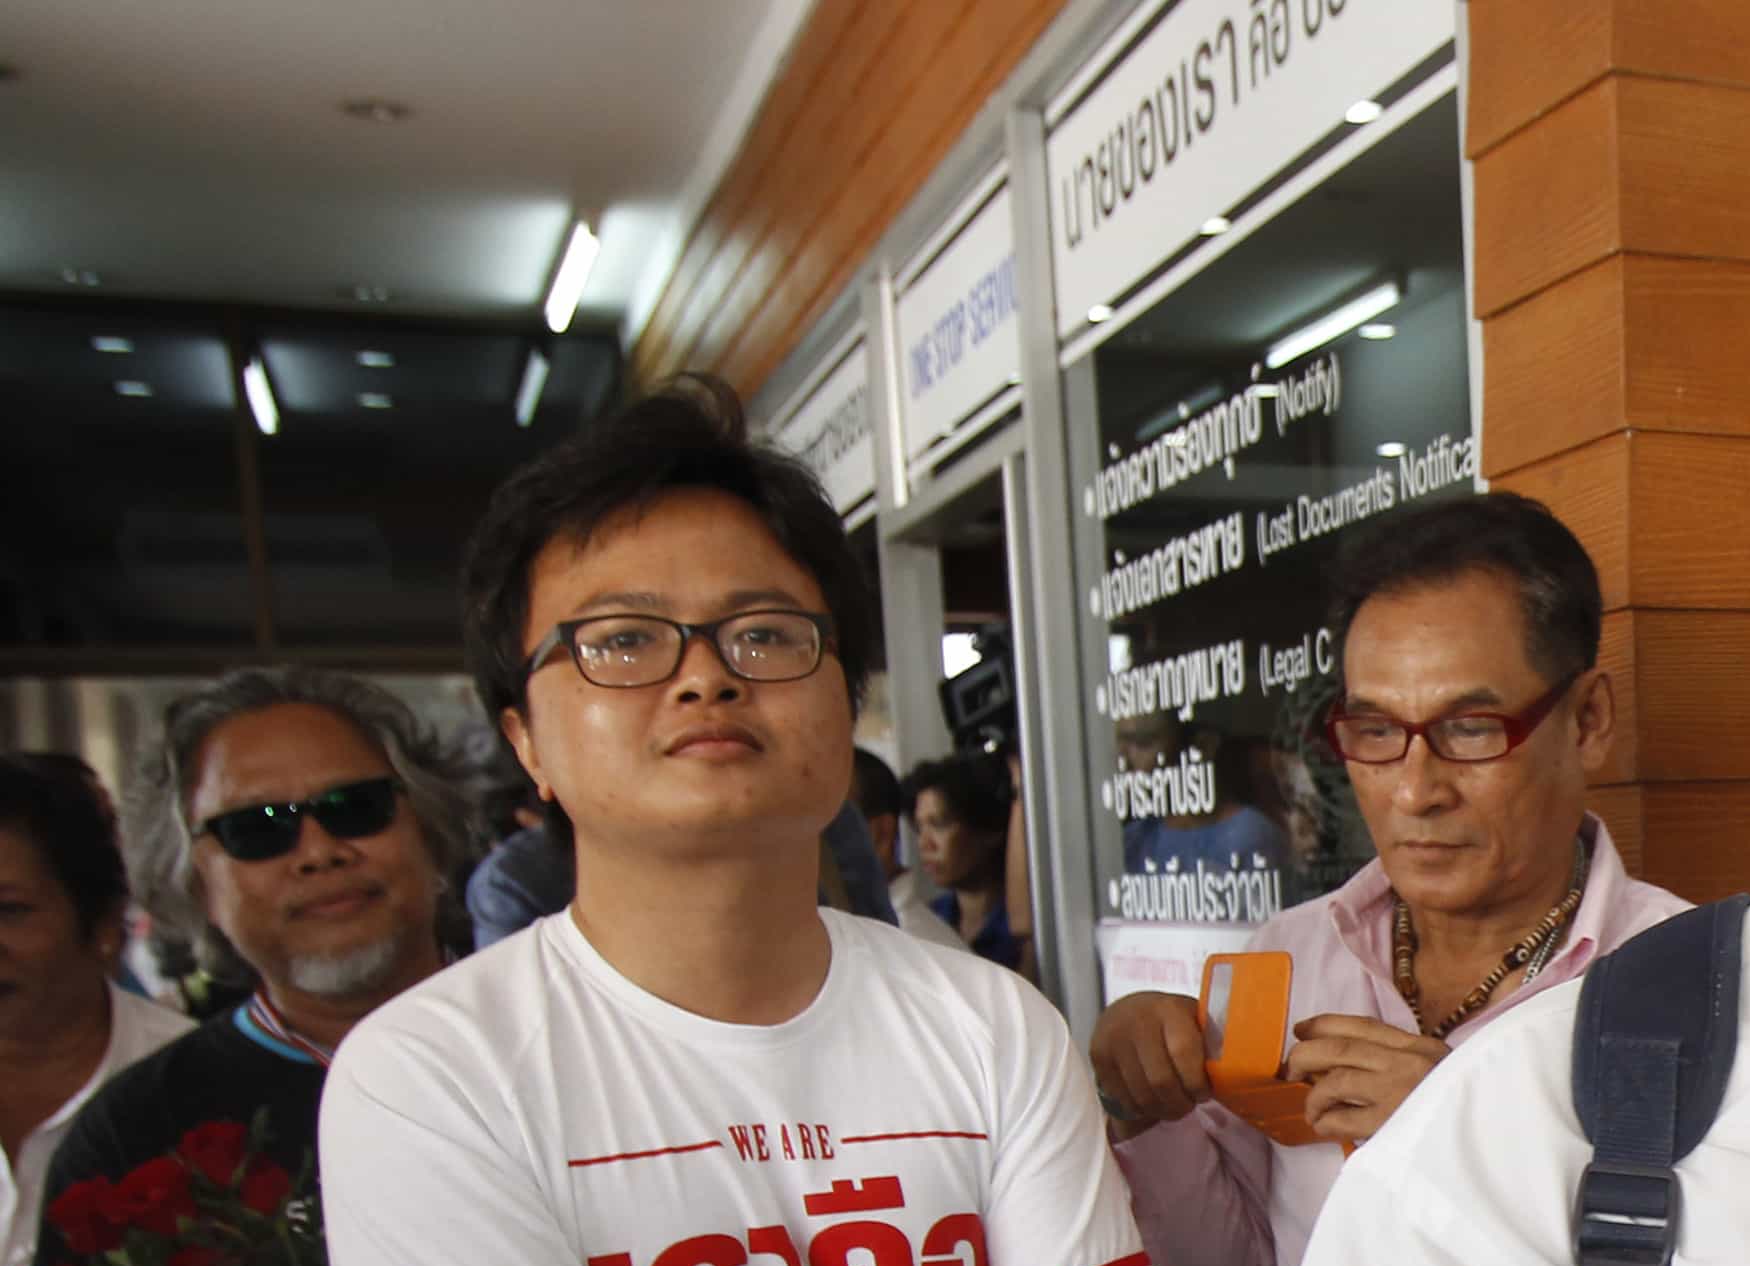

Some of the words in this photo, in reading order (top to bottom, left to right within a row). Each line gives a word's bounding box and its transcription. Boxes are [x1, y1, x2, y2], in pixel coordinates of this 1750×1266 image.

[1062, 17, 1240, 250] นายของเรา
[1275, 351, 1341, 438] (Notify)
[1102, 511, 1244, 620] แจ้งเอกสารหาย
[1256, 504, 1295, 567] (Lost
[1297, 465, 1396, 542] Documents
[1258, 632, 1312, 698] (Legal
[727, 1124, 770, 1163] WE
[780, 1123, 835, 1161] ARE
